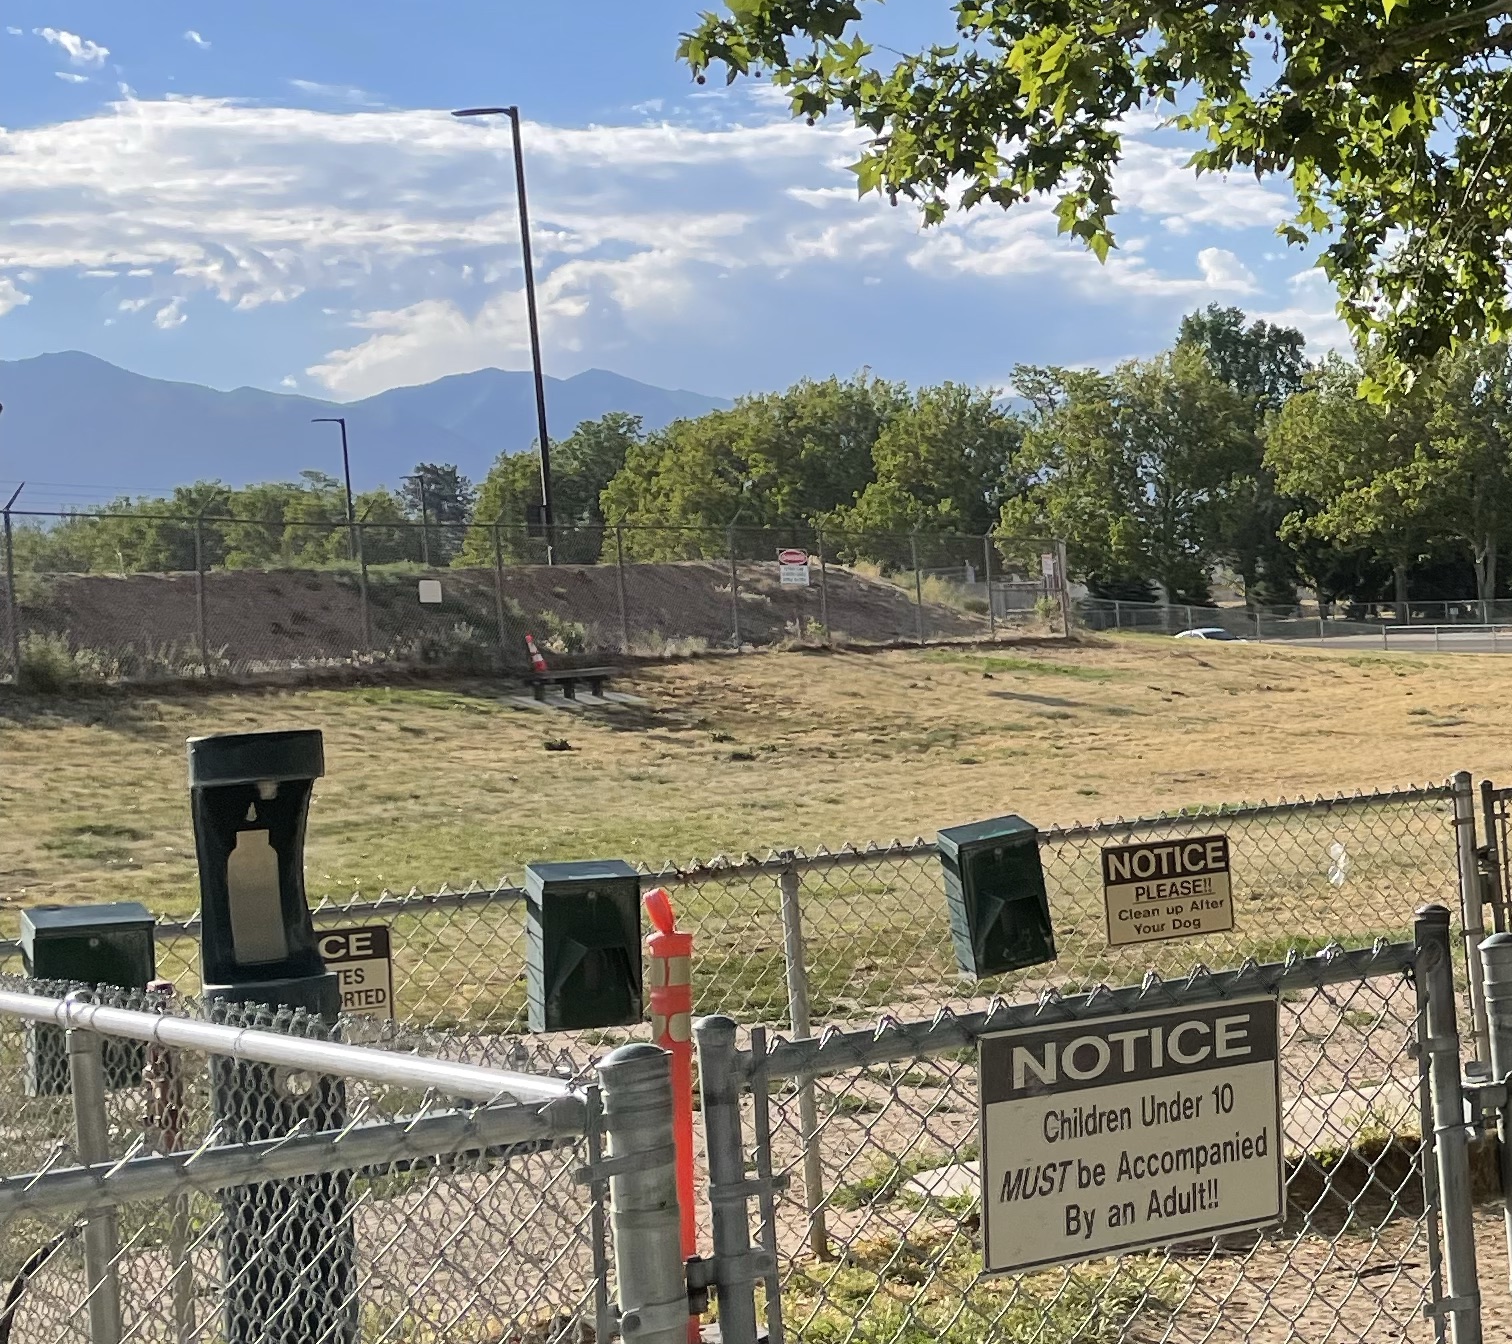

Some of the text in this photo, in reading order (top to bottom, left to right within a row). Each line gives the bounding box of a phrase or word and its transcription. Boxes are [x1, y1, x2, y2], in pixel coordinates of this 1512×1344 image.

[1108, 841, 1226, 881] NOTICE
[1118, 899, 1224, 921] Clean up After
[1135, 877, 1212, 902] PLEASE!!
[1133, 918, 1201, 935] Your Dog
[1012, 1014, 1251, 1089] NOTICE
[1044, 1083, 1234, 1144] Children Under 10
[1000, 1127, 1268, 1203] MUST be Accompanied
[1066, 1178, 1219, 1239] By an Adult!!
